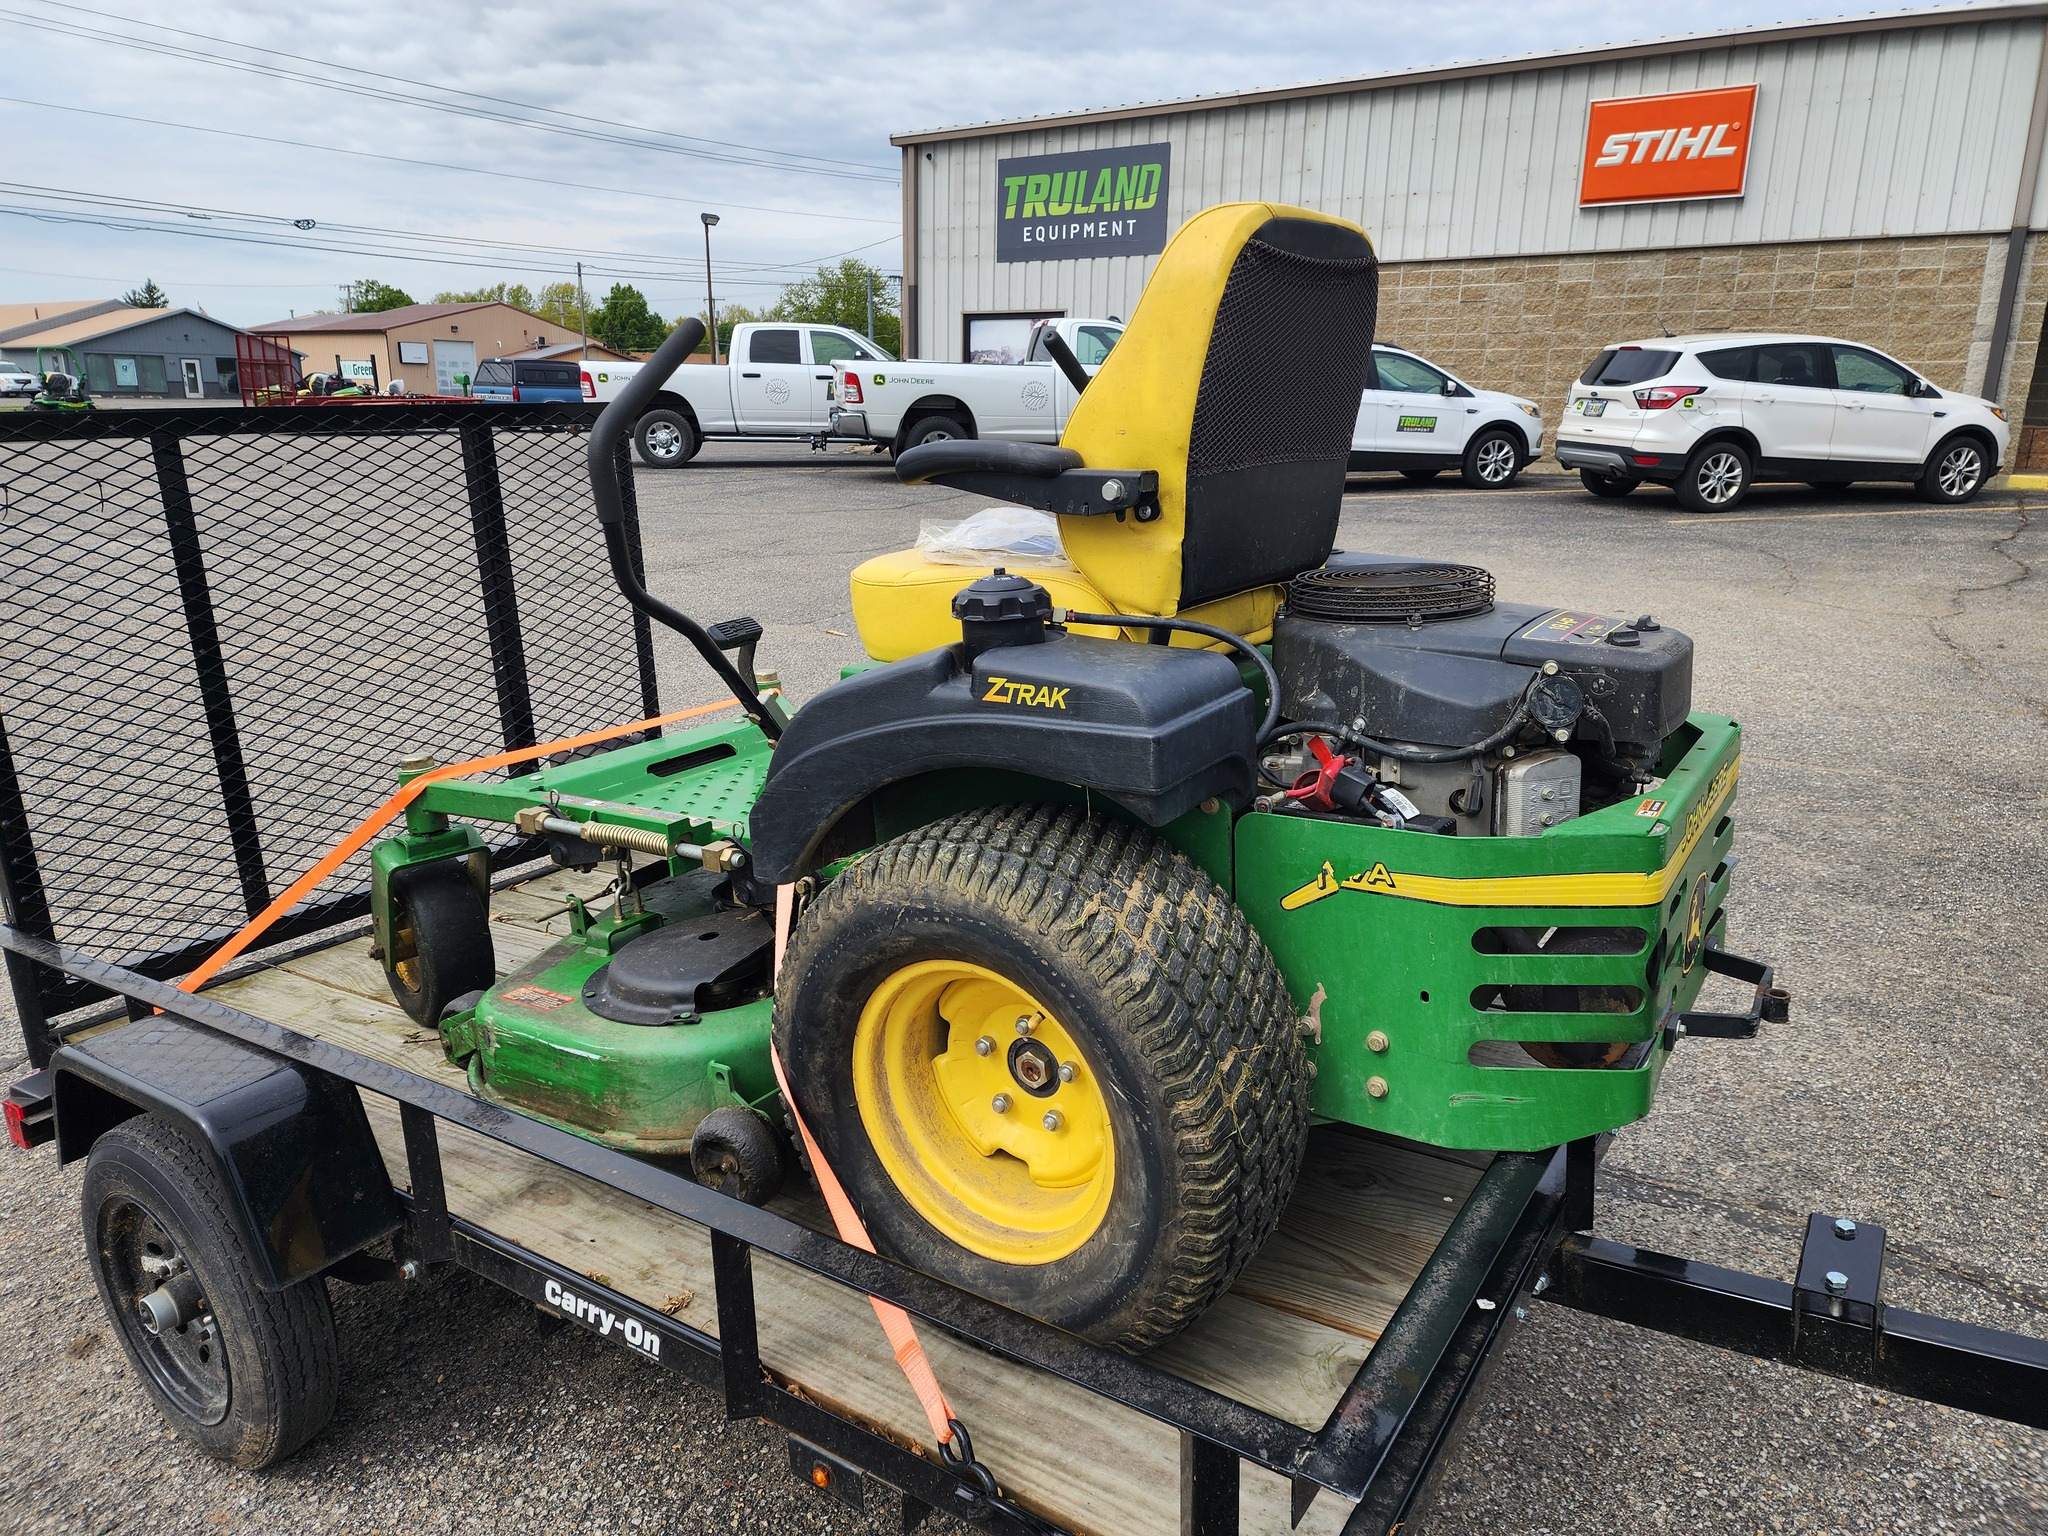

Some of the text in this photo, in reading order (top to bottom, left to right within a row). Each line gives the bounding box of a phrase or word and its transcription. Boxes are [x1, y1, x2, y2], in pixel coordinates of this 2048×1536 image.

[1594, 124, 1737, 168] STIHL
[1003, 163, 1163, 220] TRULAND
[1023, 219, 1137, 242] EQUIPMENT
[889, 376, 935, 385] JOHN DEERE
[1400, 416, 1436, 427] TRULAND
[982, 677, 1070, 709] ZTRAK
[545, 1279, 660, 1356] Carry-On
